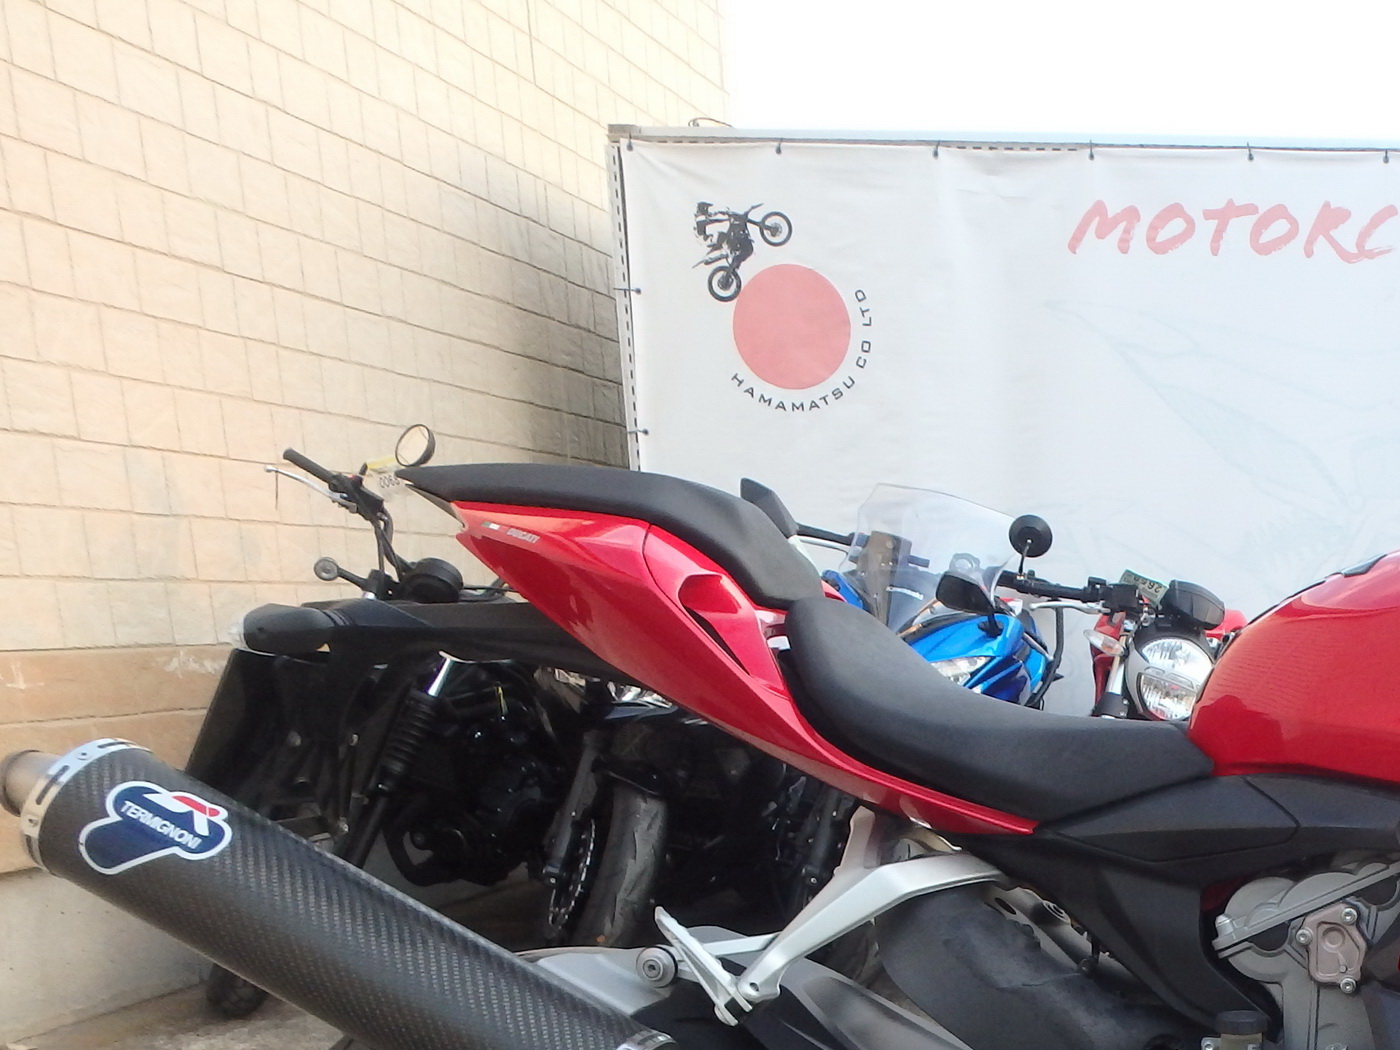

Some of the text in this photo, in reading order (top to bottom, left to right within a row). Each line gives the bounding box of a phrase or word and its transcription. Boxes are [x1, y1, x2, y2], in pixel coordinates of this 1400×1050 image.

[731, 373, 856, 412] HAMAMATSU
[854, 289, 873, 327] LTD
[121, 800, 203, 850] TERMIGNONI
